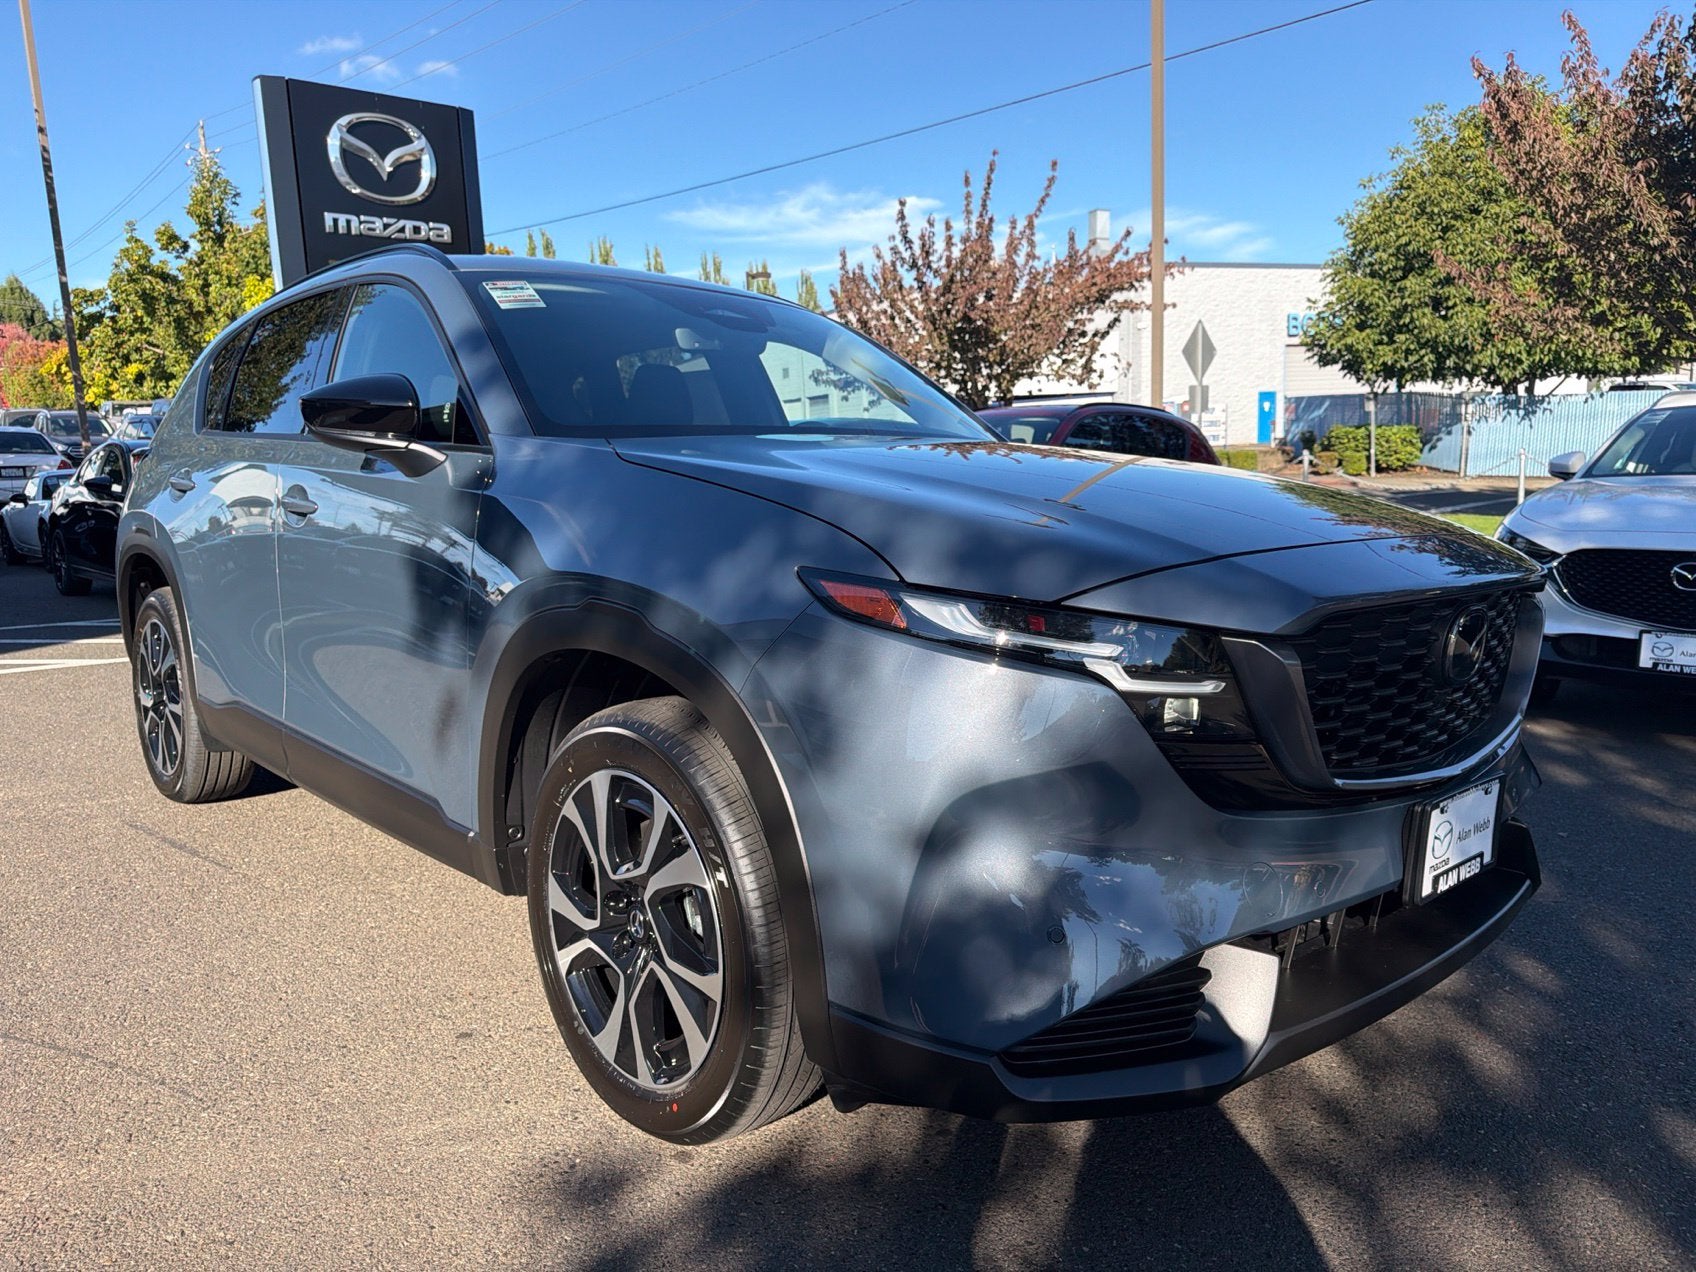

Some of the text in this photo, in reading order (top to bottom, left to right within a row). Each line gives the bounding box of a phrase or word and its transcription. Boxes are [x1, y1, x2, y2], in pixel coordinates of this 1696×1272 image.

[324, 211, 452, 243] mazda
[1657, 663, 1680, 673] ALAN
[1456, 817, 1490, 844] Alan Webb
[1437, 856, 1481, 893] ALAN WEBB
